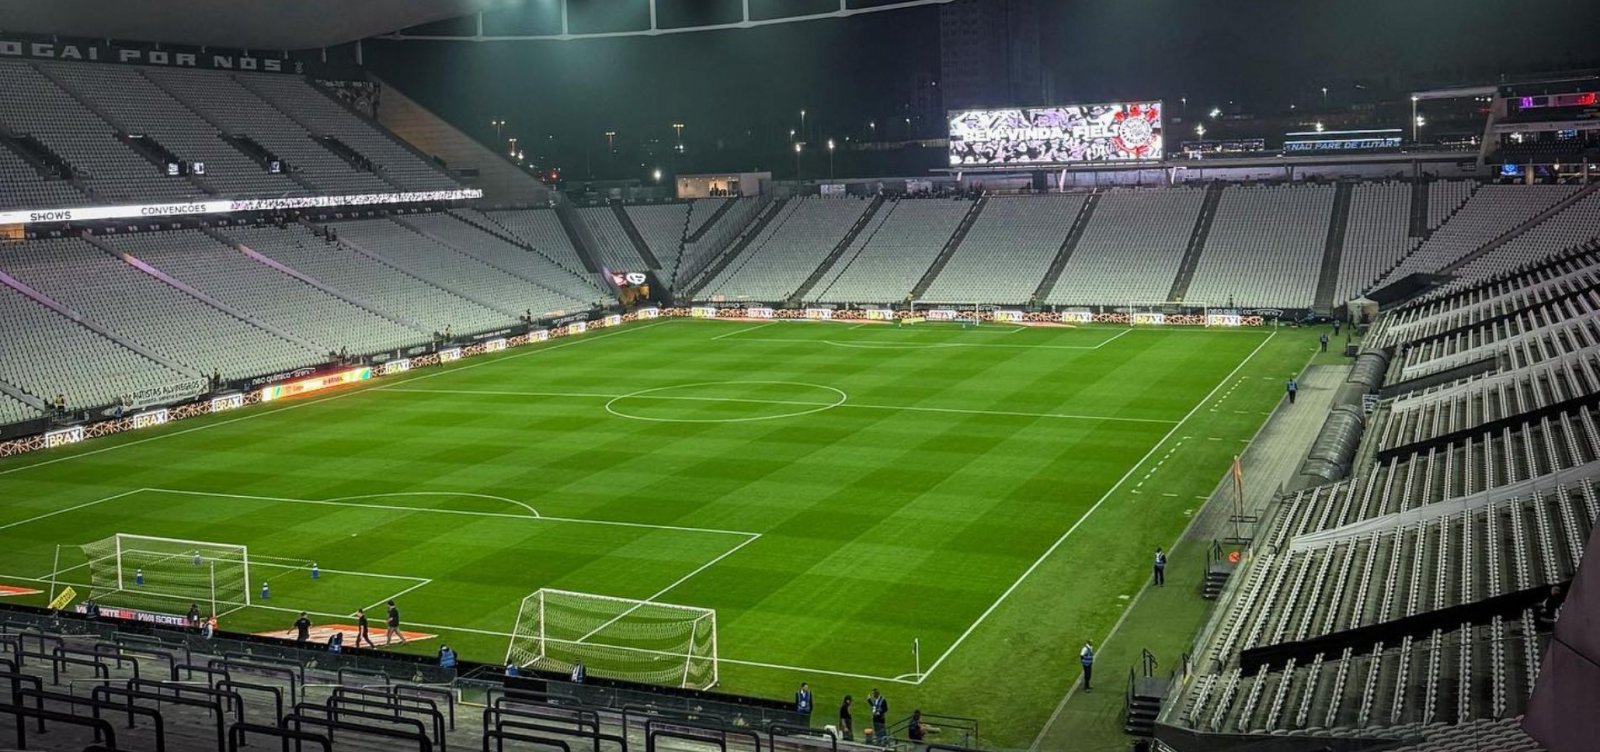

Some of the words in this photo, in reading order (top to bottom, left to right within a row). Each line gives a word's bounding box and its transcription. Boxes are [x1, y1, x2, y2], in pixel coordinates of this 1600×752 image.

[119, 49, 197, 66] POR
[1343, 140, 1359, 149] DE
[30, 211, 72, 221] SHOWS
[48, 430, 81, 448] BRAX
